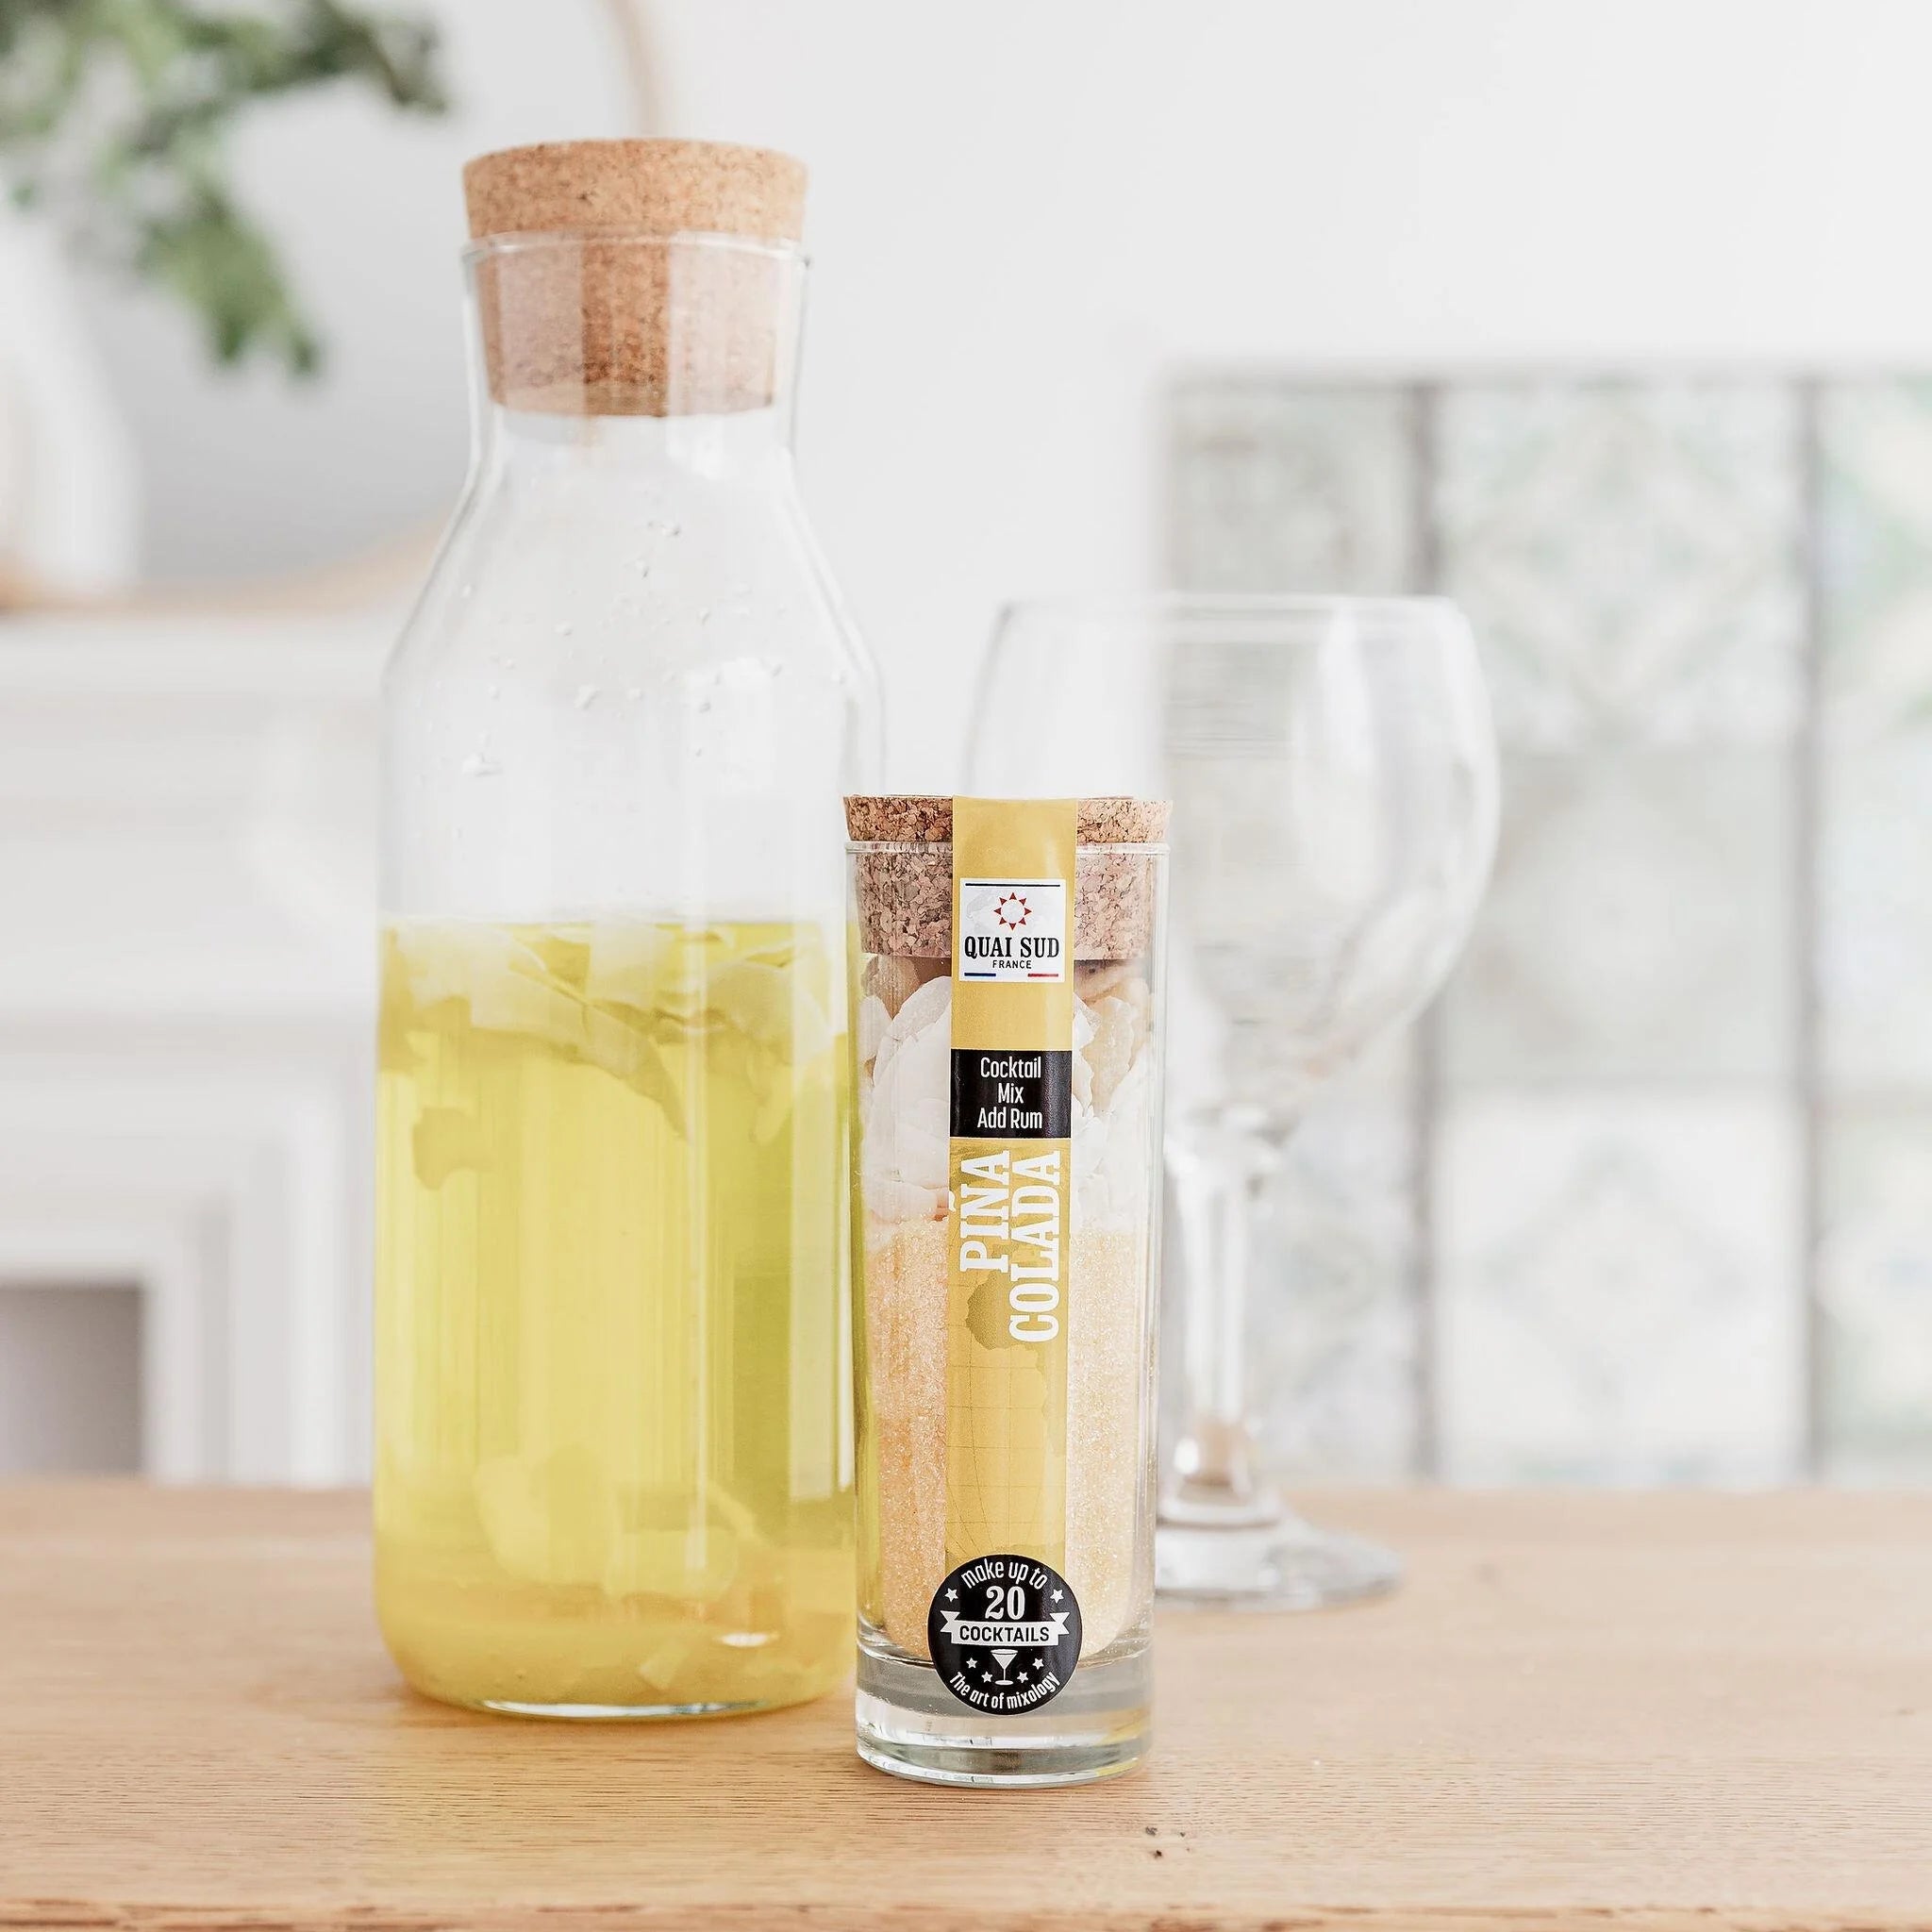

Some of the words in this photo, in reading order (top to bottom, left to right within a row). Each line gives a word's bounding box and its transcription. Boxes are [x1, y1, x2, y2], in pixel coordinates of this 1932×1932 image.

[964, 936, 1011, 959] QUAI
[1020, 936, 1059, 958] SUD
[992, 959, 1032, 970] FRANCE
[980, 1057, 1041, 1079] Cocktail
[997, 1083, 1024, 1104] Mix
[977, 1108, 1007, 1129] Add
[1010, 1108, 1043, 1129] Rum
[949, 1150, 1010, 1273] PIÑA
[1008, 1150, 1060, 1342] COLADA
[960, 1558, 1005, 1589] make
[1008, 1562, 1029, 1585] up
[1028, 1567, 1049, 1591] to
[984, 1585, 1025, 1620] 20
[959, 1625, 1050, 1642] COCKTAILS
[949, 1671, 971, 1696] The
[969, 1690, 990, 1707] art
[991, 1692, 1006, 1709] of
[1007, 1671, 1061, 1709] mixology
